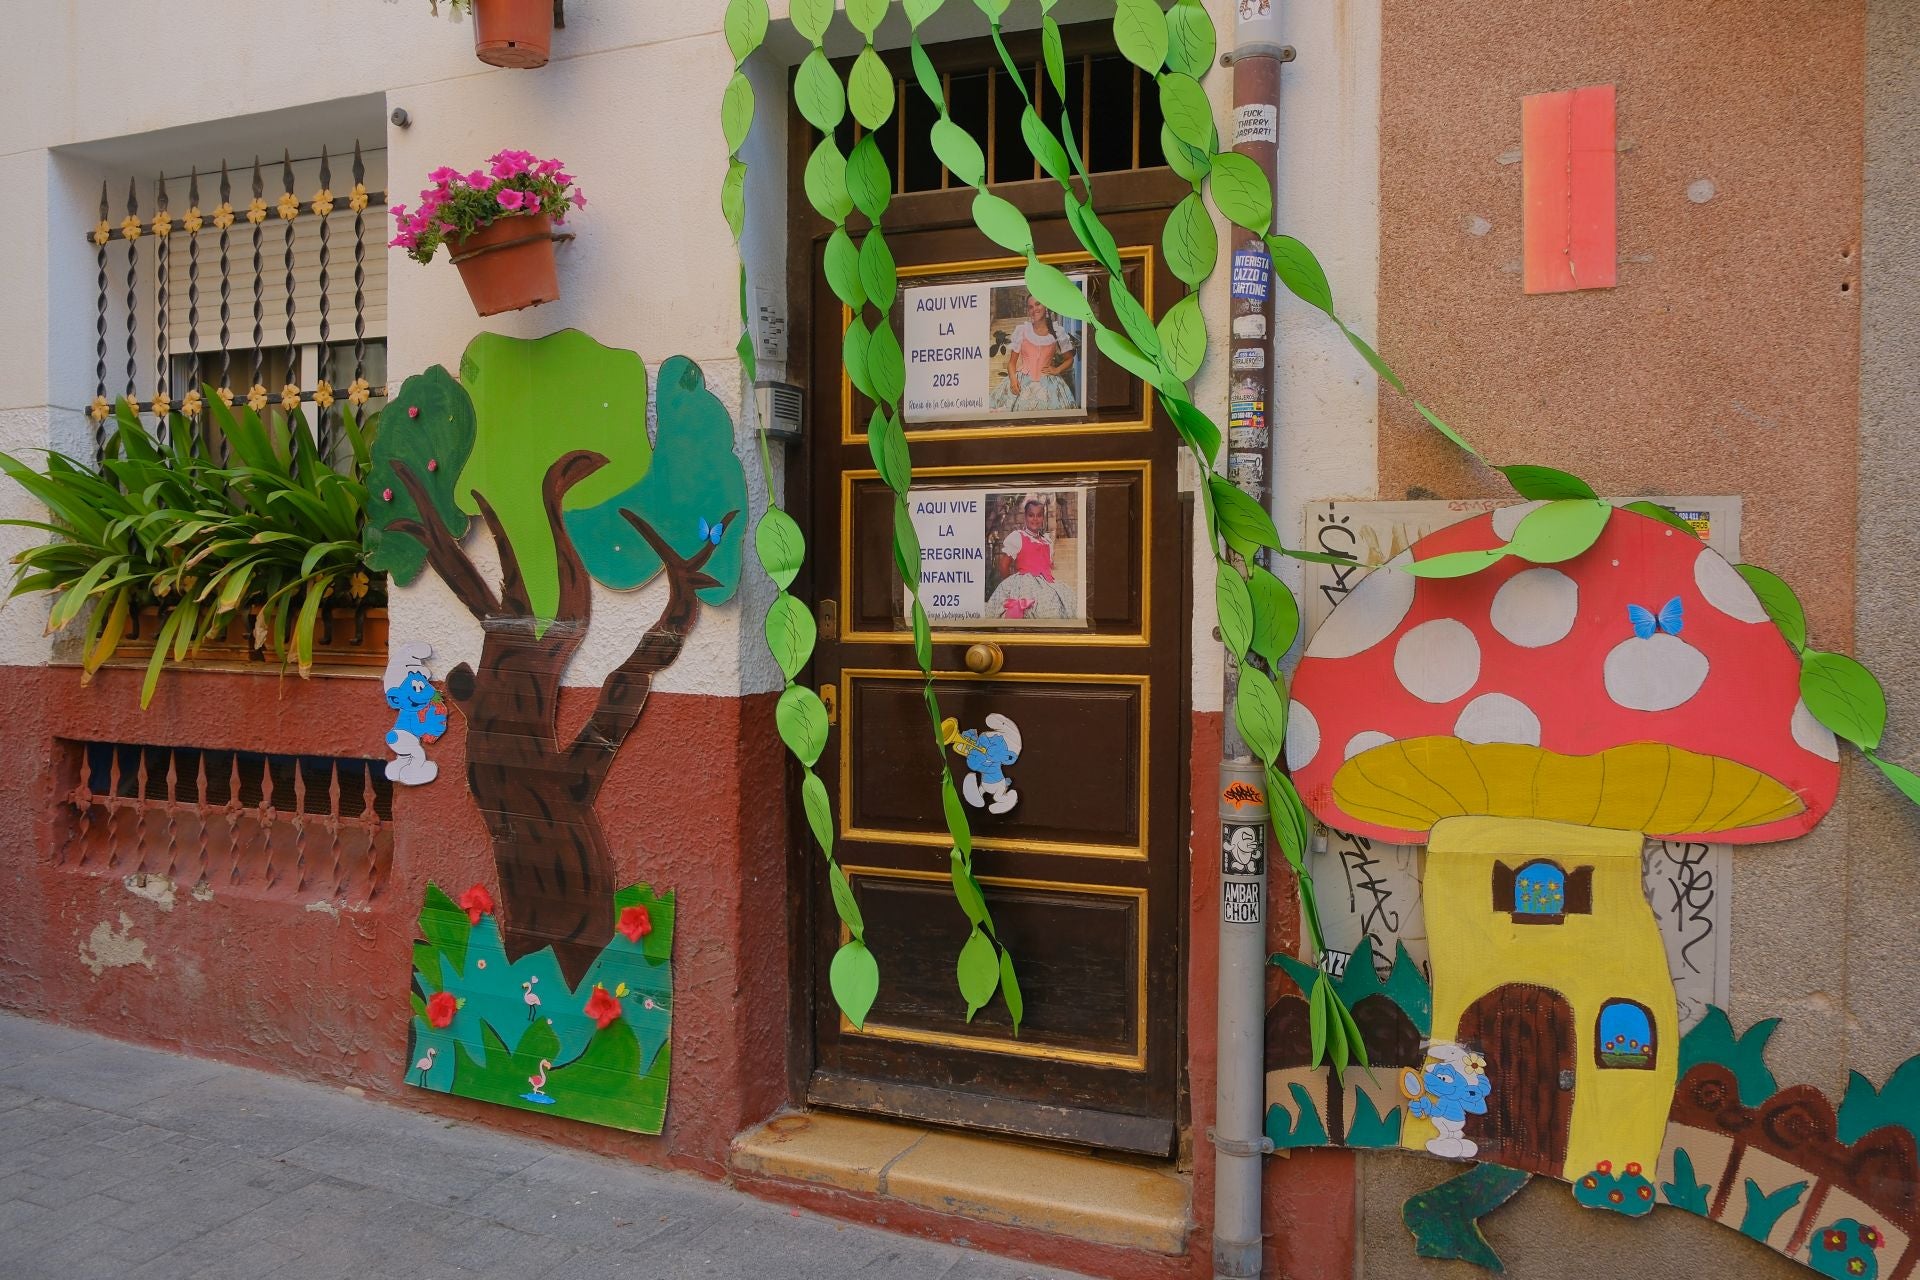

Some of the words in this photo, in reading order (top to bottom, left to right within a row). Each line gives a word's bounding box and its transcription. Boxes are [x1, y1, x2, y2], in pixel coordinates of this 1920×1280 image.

[1243, 110, 1263, 118] FUCK
[1238, 119, 1269, 129] THIERRY
[1234, 255, 1269, 270] INTERISTA
[1233, 268, 1259, 281] CAZZO
[1232, 282, 1267, 297] CARTONE
[916, 297, 946, 312] AQUI
[950, 294, 978, 309] VIVE
[939, 322, 955, 336] LA
[911, 346, 983, 363] PEREGRINA
[932, 373, 960, 388] 2025
[916, 502, 946, 514] AQUI
[950, 501, 977, 513] VIVE
[938, 525, 955, 537] LA
[920, 548, 983, 561] EREGRINA
[919, 571, 974, 584] INFANTIL
[932, 594, 960, 607] 2025
[1225, 882, 1259, 903] AMBAR
[1225, 902, 1258, 922] CHOK
